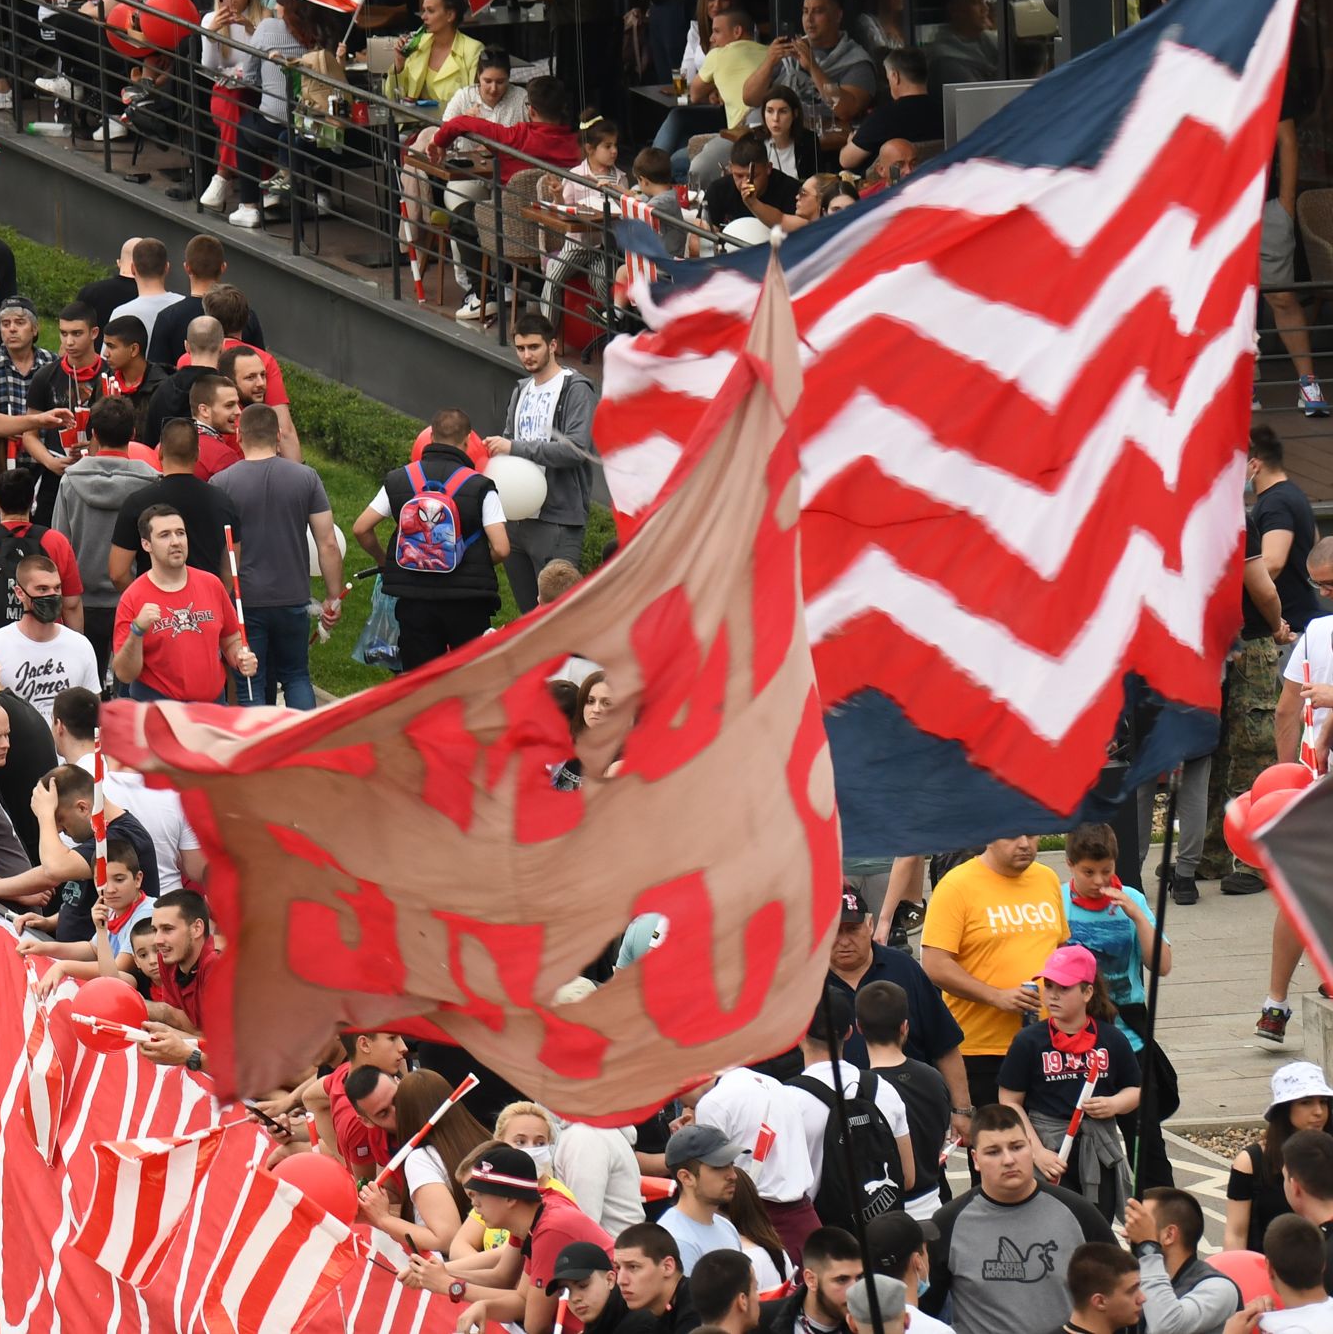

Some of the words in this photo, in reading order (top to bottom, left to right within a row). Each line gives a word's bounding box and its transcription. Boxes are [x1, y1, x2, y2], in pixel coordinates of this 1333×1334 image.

[15, 657, 54, 693] Jack
[55, 661, 66, 675] &
[24, 677, 71, 703] Jones
[986, 901, 1056, 929] HUGO
[983, 1269, 1025, 1279] HOOLIGAN
[985, 1261, 1023, 1271] PEACEFUL
